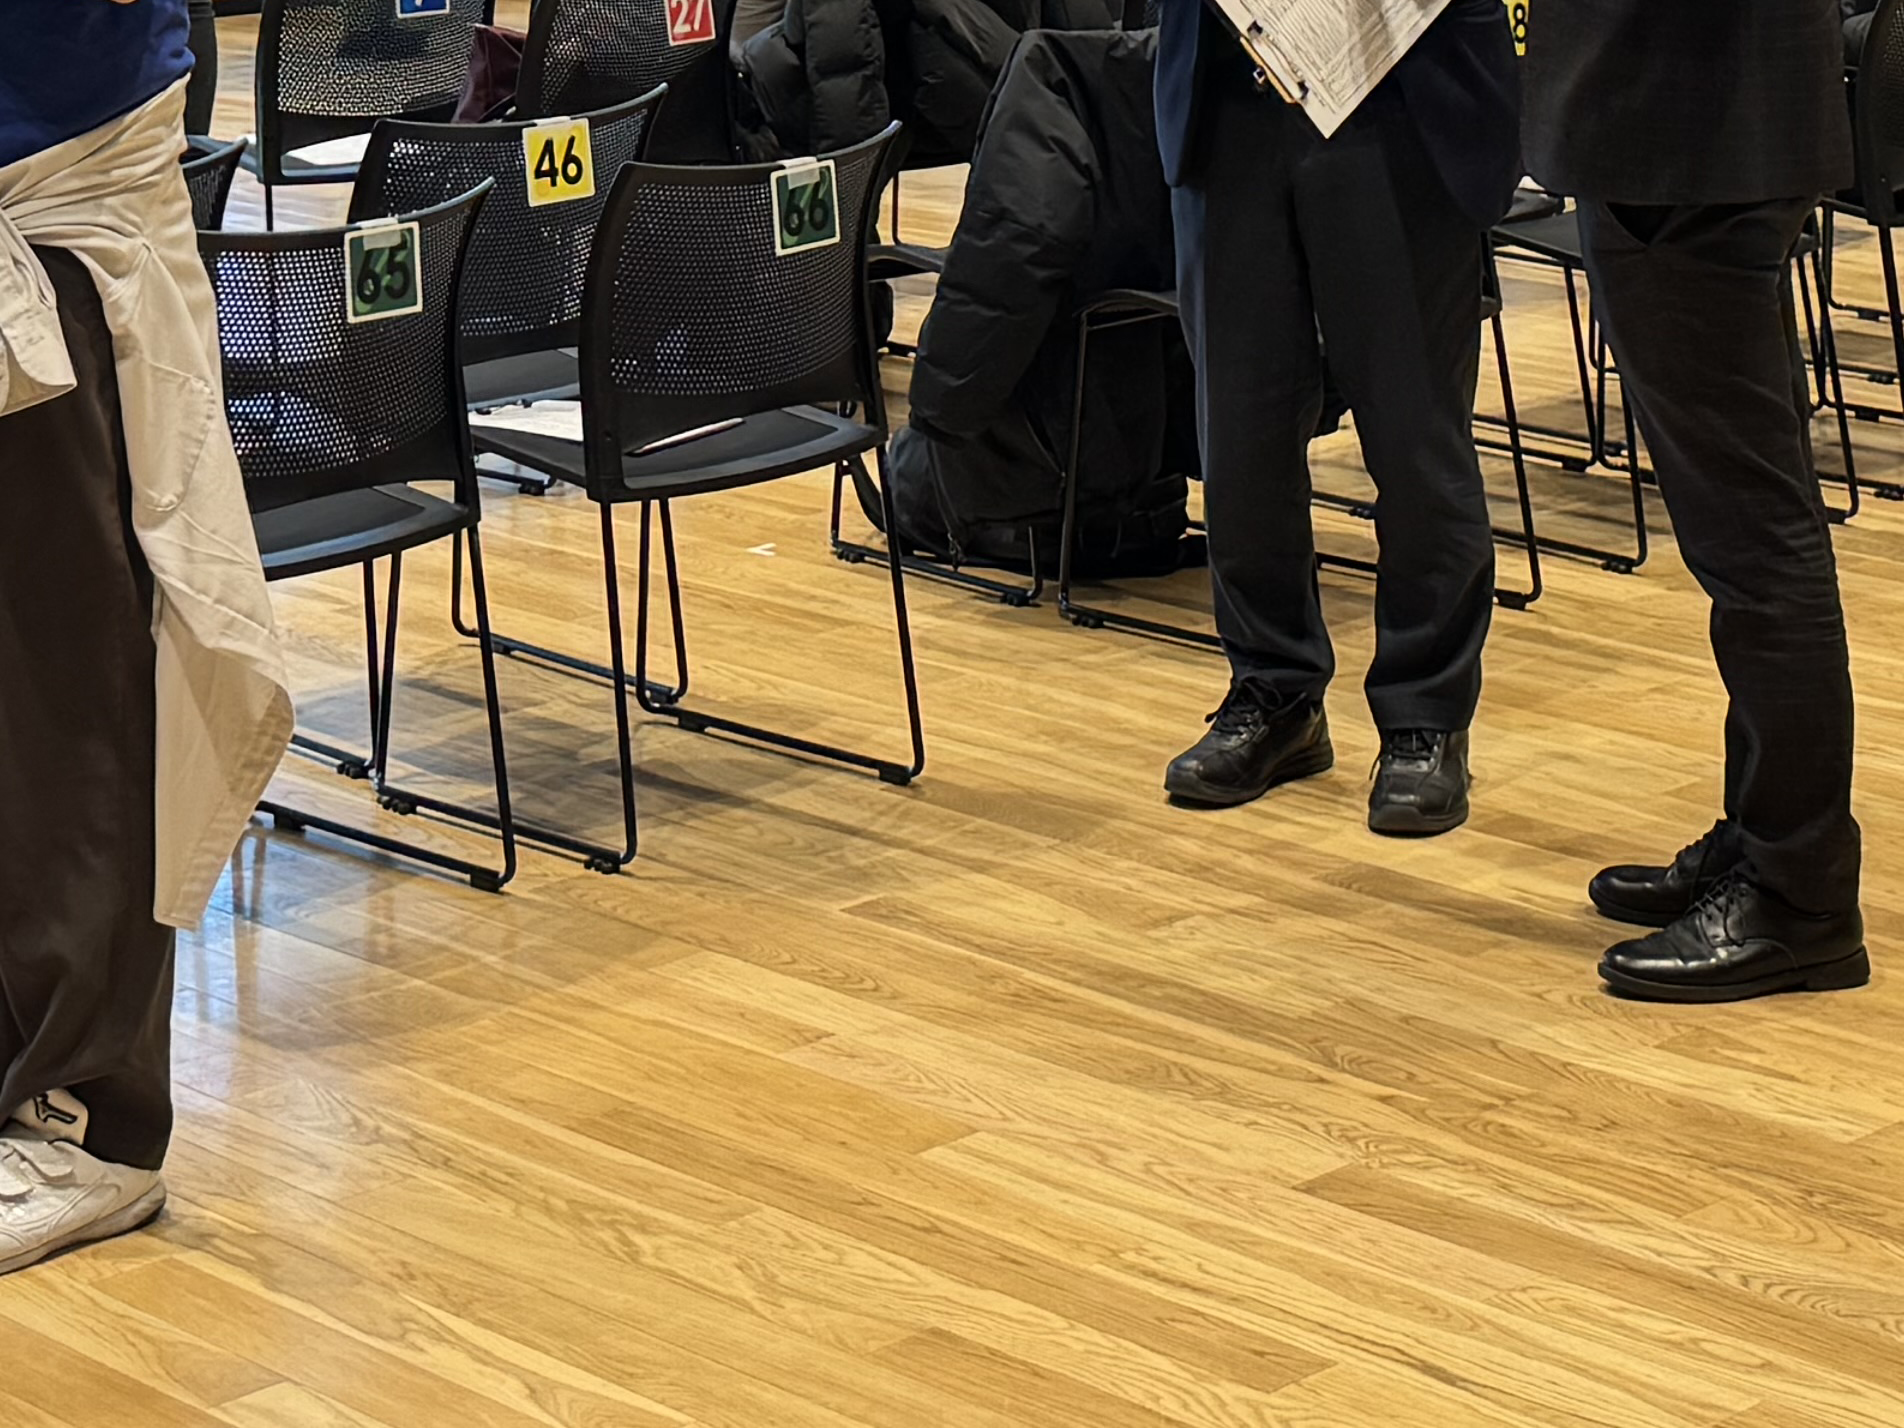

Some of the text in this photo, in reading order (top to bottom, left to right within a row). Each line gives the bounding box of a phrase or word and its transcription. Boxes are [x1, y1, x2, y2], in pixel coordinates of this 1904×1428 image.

[532, 134, 584, 188] 46
[784, 177, 829, 237] 66
[356, 238, 412, 304] 65
